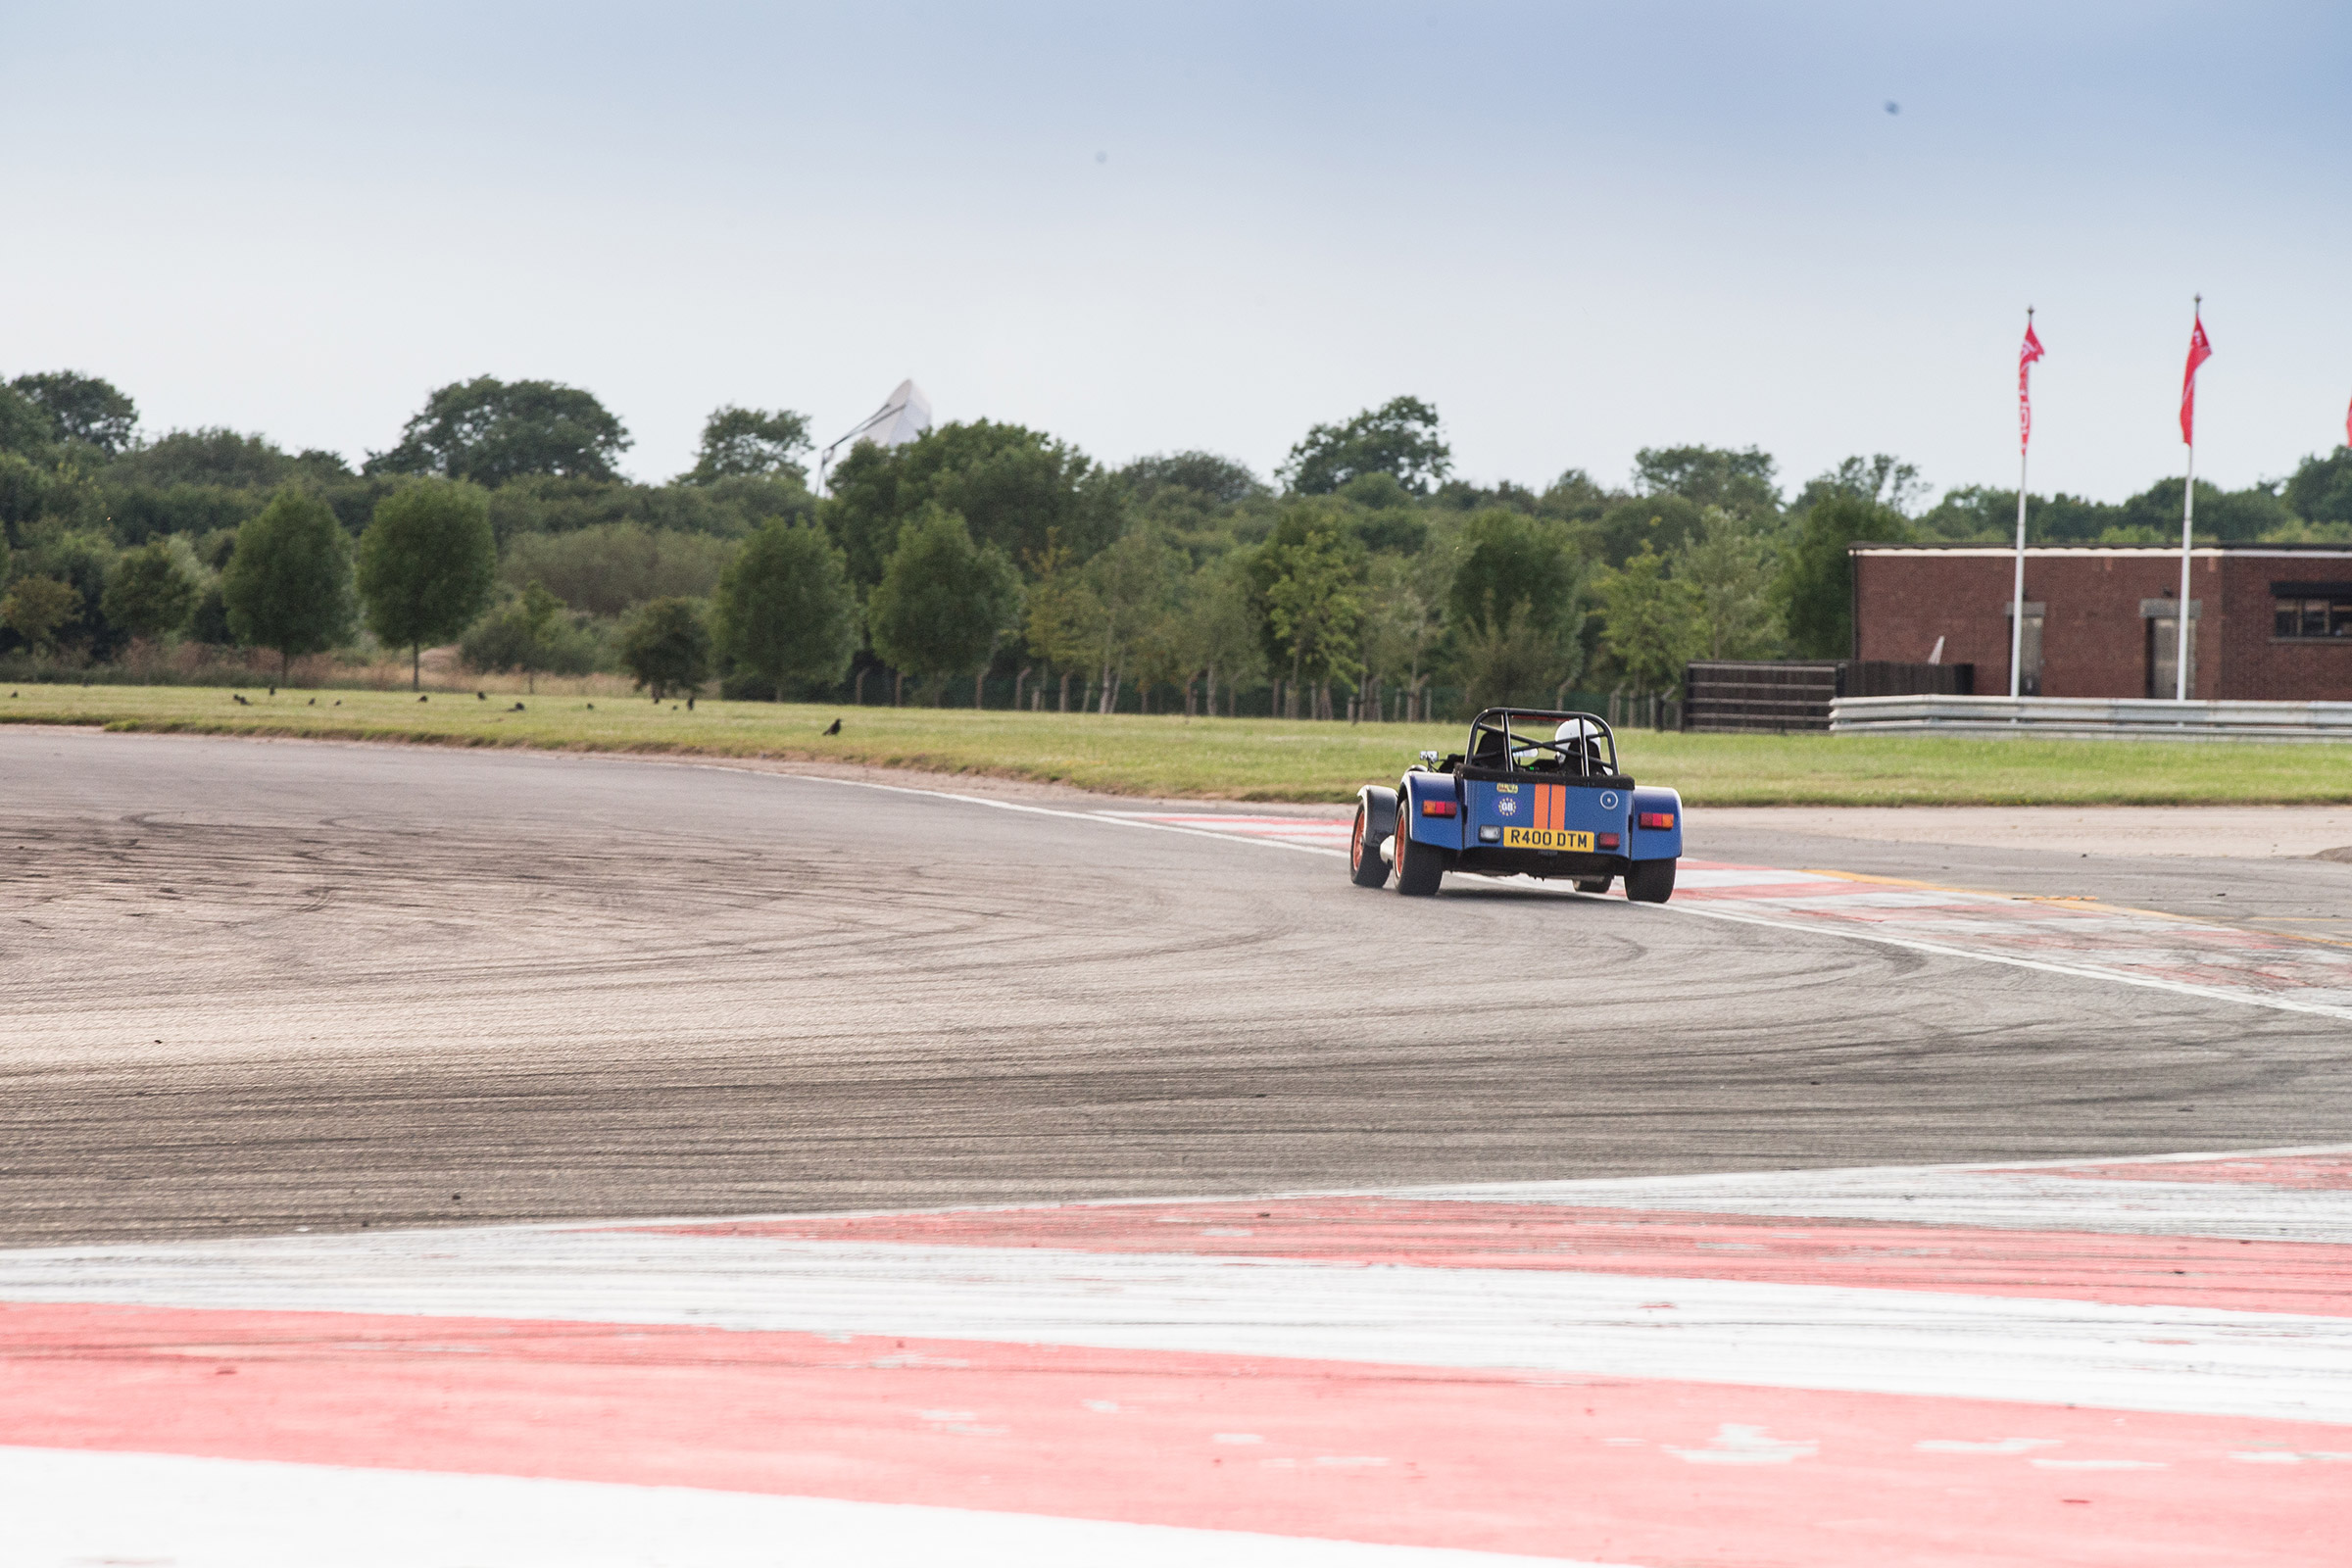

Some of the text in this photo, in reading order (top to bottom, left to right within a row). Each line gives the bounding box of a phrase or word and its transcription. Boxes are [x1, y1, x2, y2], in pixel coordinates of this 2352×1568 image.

[1501, 802, 1513, 811] GB
[1510, 829, 1588, 848] R400 DTM
